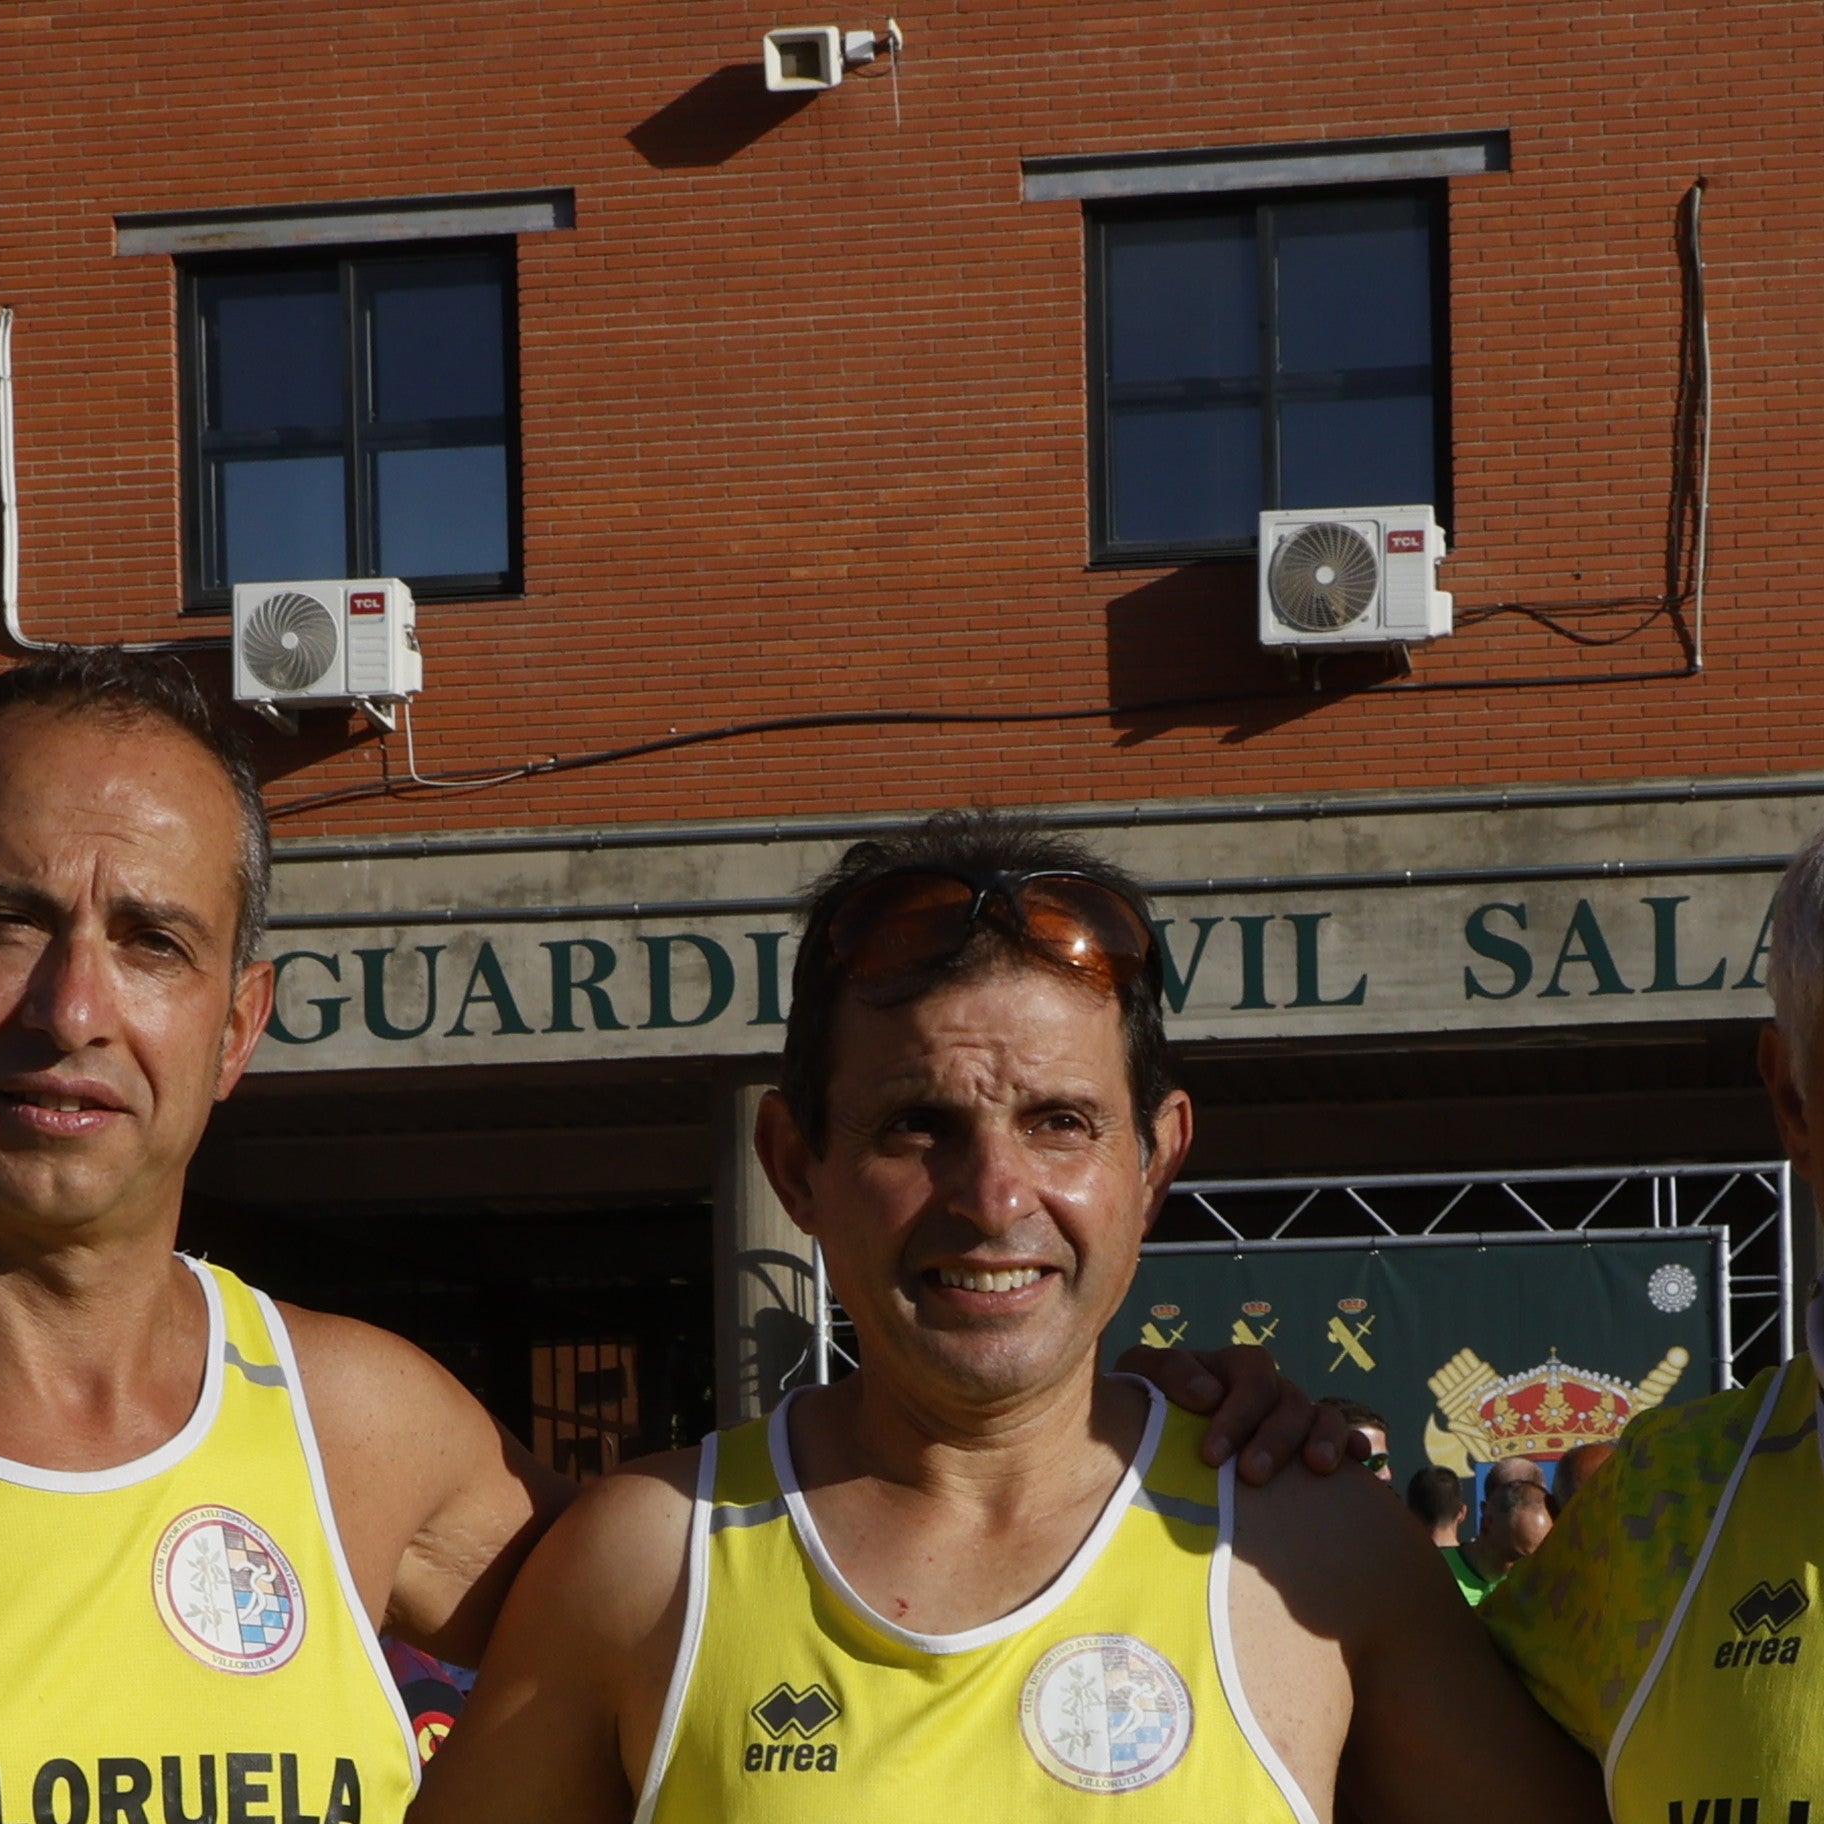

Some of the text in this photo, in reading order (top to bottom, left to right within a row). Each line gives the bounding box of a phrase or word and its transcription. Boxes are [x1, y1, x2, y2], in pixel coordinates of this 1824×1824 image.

[1391, 537, 1419, 548] TCL
[354, 599, 381, 609] TCL
[266, 932, 788, 1044] GUARDI
[1151, 911, 1368, 1014] VIL
[156, 1558, 165, 1585] CLUB
[161, 1513, 198, 1556] DEPORTIVO
[211, 1653, 277, 1671] VILLORUELA
[1713, 1633, 1802, 1670] errea
[744, 1742, 838, 1773] errea
[1078, 1772, 1148, 1788] VILLORUELA
